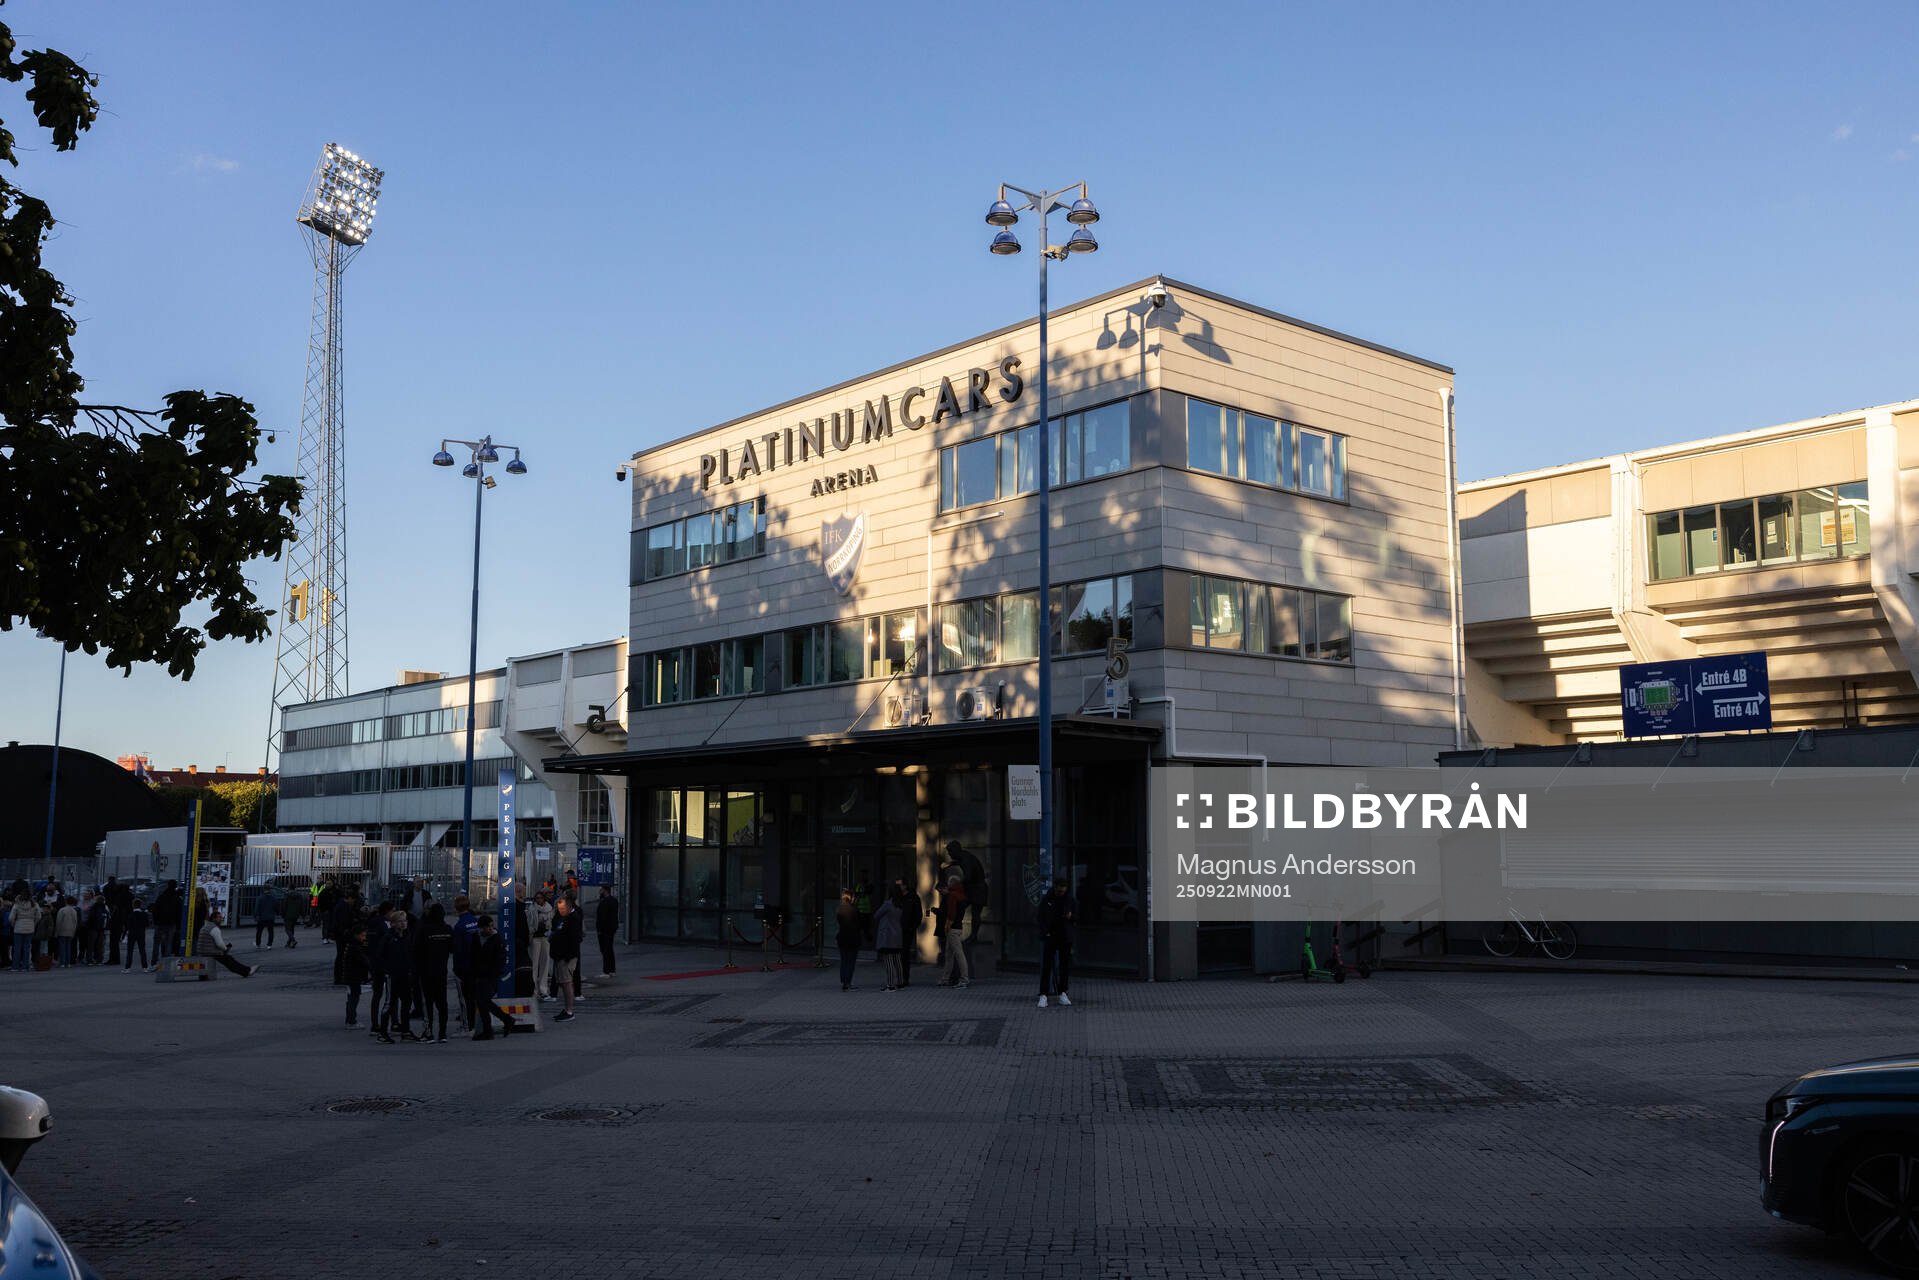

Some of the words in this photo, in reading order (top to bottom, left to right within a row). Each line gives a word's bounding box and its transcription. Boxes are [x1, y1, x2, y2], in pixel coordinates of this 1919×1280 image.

[700, 355, 1023, 490] PLATINUMCARS
[810, 464, 879, 497] ARENA
[825, 528, 843, 545] IFK
[1702, 670, 1730, 686] Entré
[1733, 669, 1747, 683] 4B
[1714, 703, 1742, 718] Entré
[1745, 702, 1760, 716] 4A
